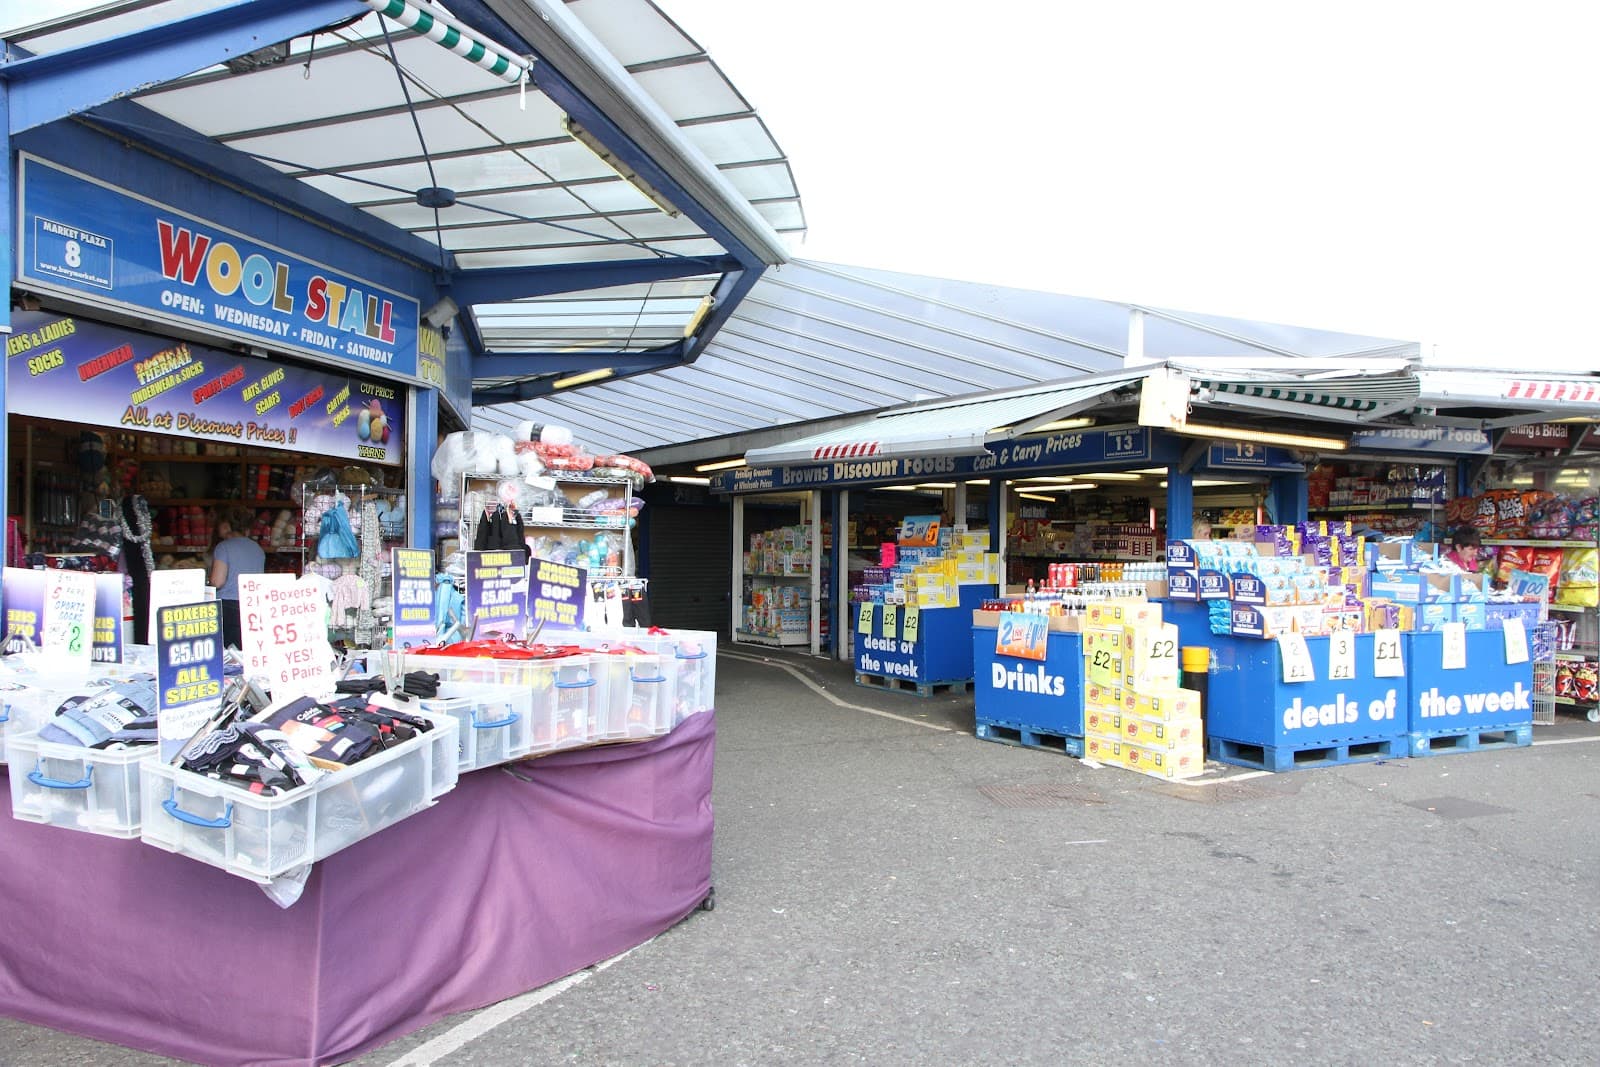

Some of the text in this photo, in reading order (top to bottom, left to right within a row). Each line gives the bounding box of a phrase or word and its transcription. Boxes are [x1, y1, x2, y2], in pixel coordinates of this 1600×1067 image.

[43, 221, 106, 248] MARKET PLAZA
[65, 240, 80, 268] 8
[157, 218, 294, 315] WOOL
[303, 275, 397, 345] STALL
[31, 332, 41, 347] &
[40, 318, 76, 343] LADIES
[161, 290, 205, 315] OPEN:
[214, 304, 290, 337] WEDNESDAY
[300, 328, 338, 349] FRIDAY
[346, 341, 394, 365] SATURDAY
[28, 348, 64, 376] SOCKS
[77, 343, 134, 382] UNDERWEAR
[136, 348, 192, 386] THERMAL
[131, 375, 175, 406] UNDERWEAR
[181, 360, 204, 381] SOCKS
[261, 368, 285, 390] GLOVES
[326, 385, 350, 415] CARTOON
[360, 383, 395, 400] CUT PRICE
[255, 391, 281, 416] SCARFS
[122, 405, 149, 426] All
[154, 411, 173, 429] at
[177, 413, 243, 439] Discount
[246, 421, 285, 444] Prices
[332, 404, 350, 427] SOCKS
[1447, 428, 1488, 444] Foods
[1543, 423, 1568, 438] Bridal
[357, 445, 386, 459] YARNS
[1000, 448, 1009, 465] &
[1012, 444, 1042, 462] Carry
[1045, 434, 1082, 454] Prices
[1116, 435, 1132, 451] 13
[1236, 442, 1254, 457] 13
[782, 456, 955, 485] Browns Discount Foods
[904, 521, 915, 538] 3
[537, 571, 579, 587] GLOVES
[398, 589, 432, 605] £5.00
[481, 589, 512, 605] £5.00
[541, 583, 572, 601] 50P
[163, 604, 218, 624] BOXERS
[270, 603, 317, 618] 2 Packs
[535, 598, 555, 611] ONE
[861, 610, 871, 622] £2
[884, 613, 894, 625] £2
[905, 617, 916, 628] £2
[164, 620, 218, 641] 6 PAIRS
[273, 623, 297, 645] £5
[1001, 621, 1013, 645] 2
[169, 639, 214, 666] £5.00
[864, 634, 914, 655] deals of
[1150, 640, 1174, 658] £2
[1290, 642, 1298, 655] 2
[1339, 640, 1347, 655] 3
[1376, 641, 1400, 659] £1
[285, 648, 314, 664] YES!
[861, 653, 918, 678] the week
[1093, 650, 1111, 669] £2
[177, 665, 210, 686] ALL
[281, 665, 323, 683] 6 Pairs
[992, 662, 1064, 696] Drinks
[1290, 666, 1307, 678] £1
[1333, 665, 1349, 678] £1
[166, 682, 221, 705] SIZES
[1283, 682, 1530, 730] deals of the week
